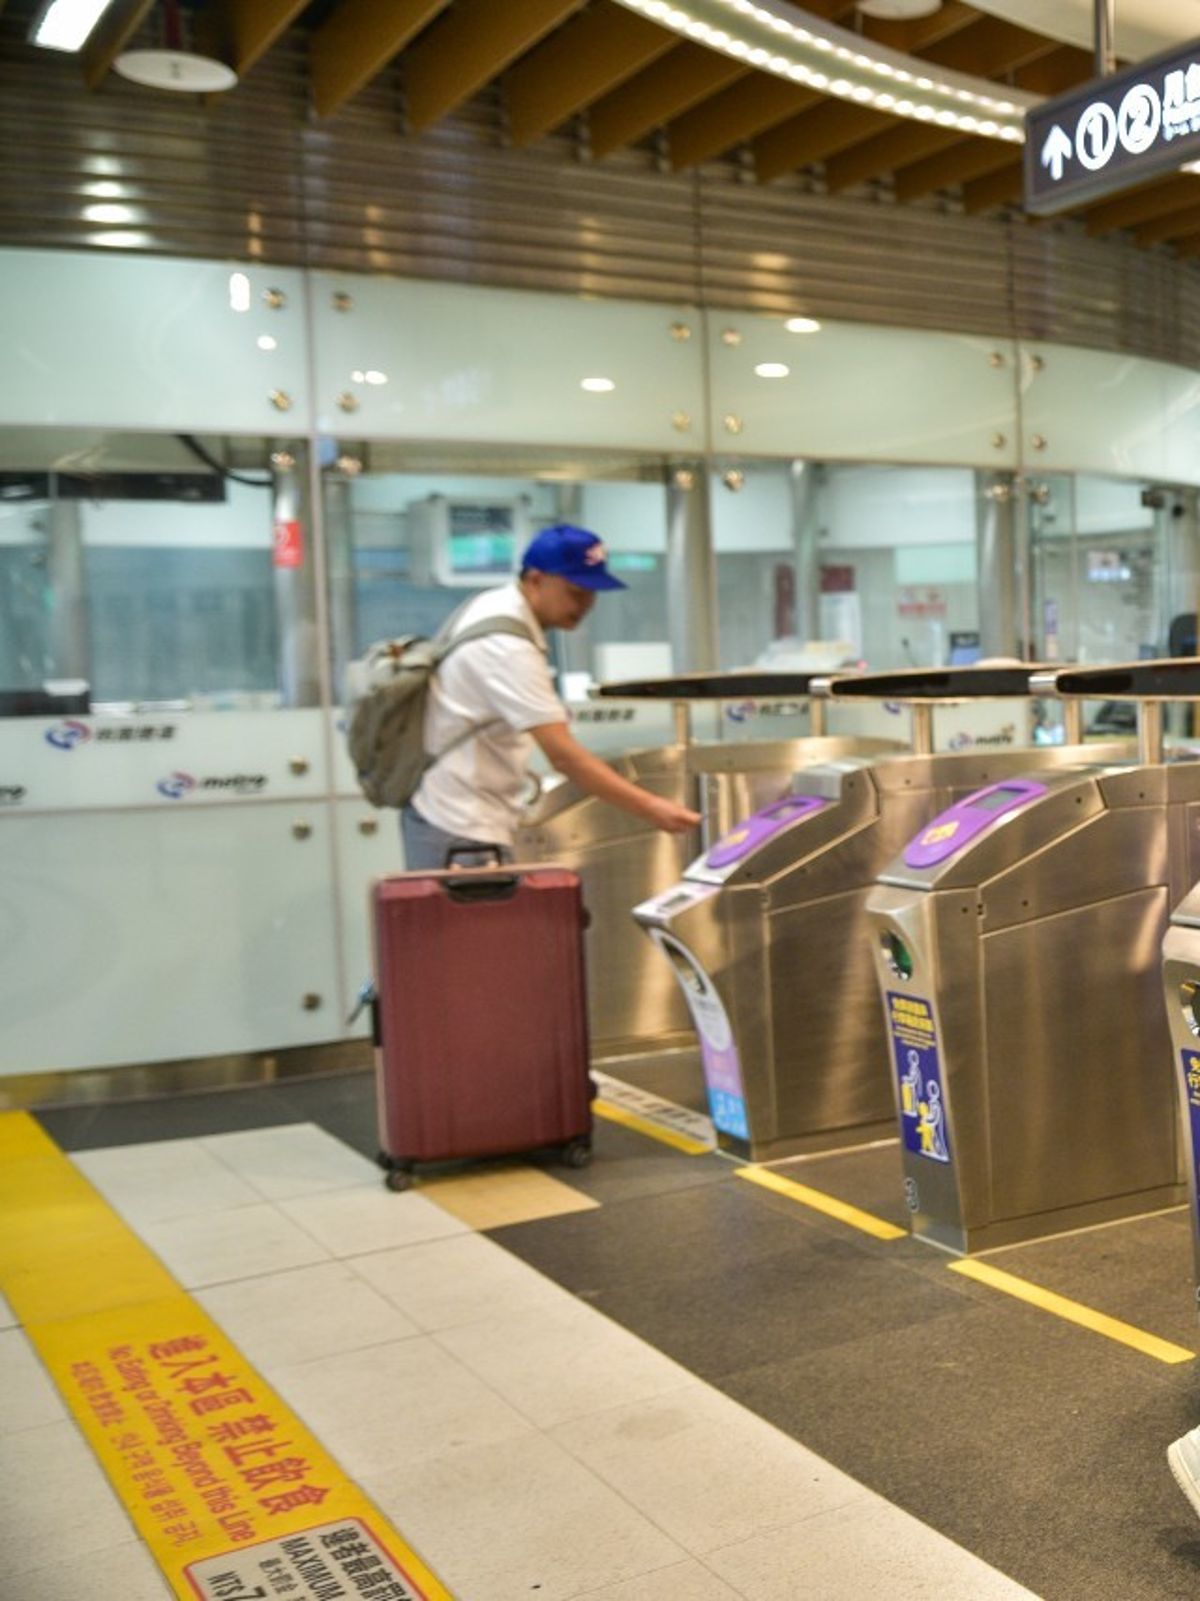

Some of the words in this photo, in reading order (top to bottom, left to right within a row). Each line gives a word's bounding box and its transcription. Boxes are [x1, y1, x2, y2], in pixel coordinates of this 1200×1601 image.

[170, 1440, 228, 1489] Beyond
[217, 1510, 257, 1543] Line
[206, 1413, 331, 1515] 禁止飲食
[279, 1536, 347, 1601] MAXIMUM
[318, 1526, 412, 1601] 違者最高罰
